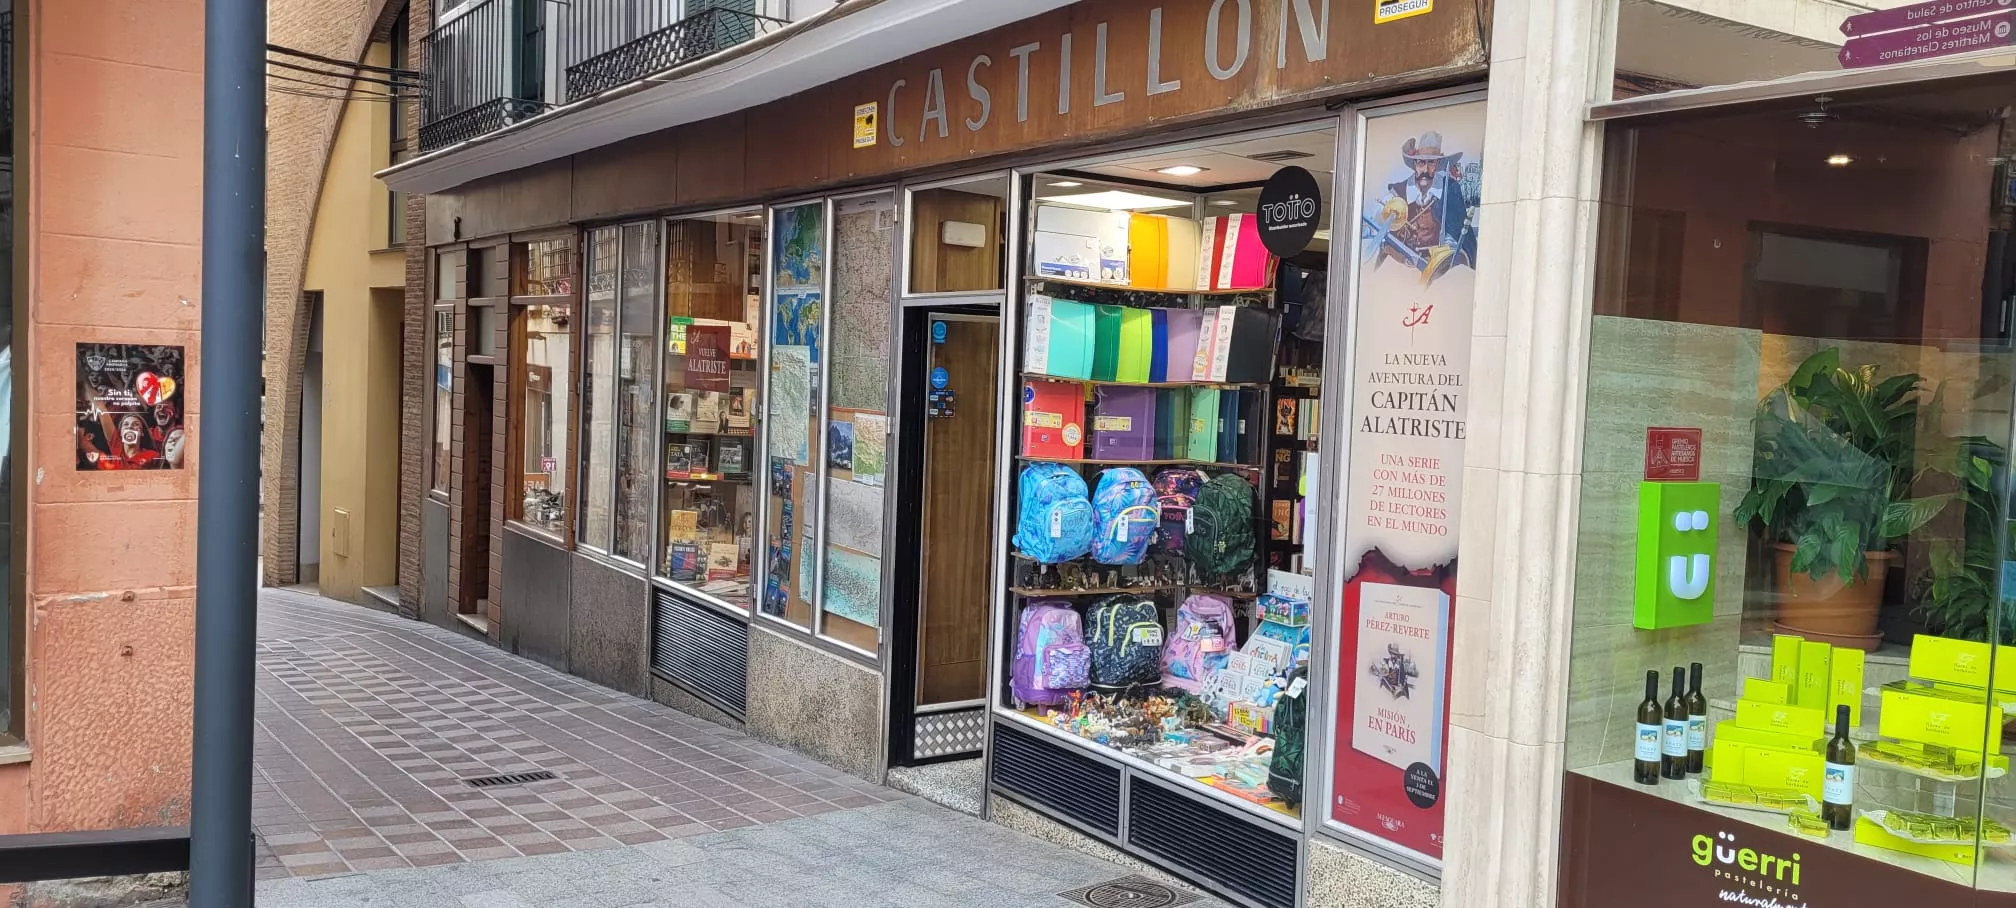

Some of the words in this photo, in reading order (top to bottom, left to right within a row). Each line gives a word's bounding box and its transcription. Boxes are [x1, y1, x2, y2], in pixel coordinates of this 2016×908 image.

[1379, 0, 1428, 17] PROSEGUR
[886, 0, 1328, 146] CASTILLON
[688, 358, 728, 374] ALATRISTE
[1384, 353, 1400, 365] LA
[1403, 353, 1447, 367] NUEVA
[1368, 371, 1434, 386] AVENTURA
[1438, 373, 1463, 388] DEL
[1371, 388, 1459, 413] CAPITÁN
[1360, 415, 1466, 440] ALATRISTE
[1381, 453, 1405, 467] UNA
[1407, 456, 1440, 470] SERIE
[1373, 468, 1398, 481] CON
[1401, 470, 1426, 485] MÁS
[1429, 474, 1446, 487] DE
[1371, 484, 1385, 497] 27
[1387, 486, 1446, 504] MILLONES
[1369, 499, 1385, 512] DE
[1388, 502, 1447, 521] LECTORES
[1367, 515, 1382, 527] EN
[1385, 517, 1400, 530] EL
[1400, 519, 1448, 537] MUNDO
[1384, 611, 1410, 623] ARTURO
[1366, 616, 1431, 640] PÉREZ-REVERTE
[1377, 707, 1407, 724] MISIÓN
[1368, 715, 1384, 733] EN
[1385, 723, 1416, 745] PARÍS
[1691, 831, 1801, 886] güerri
